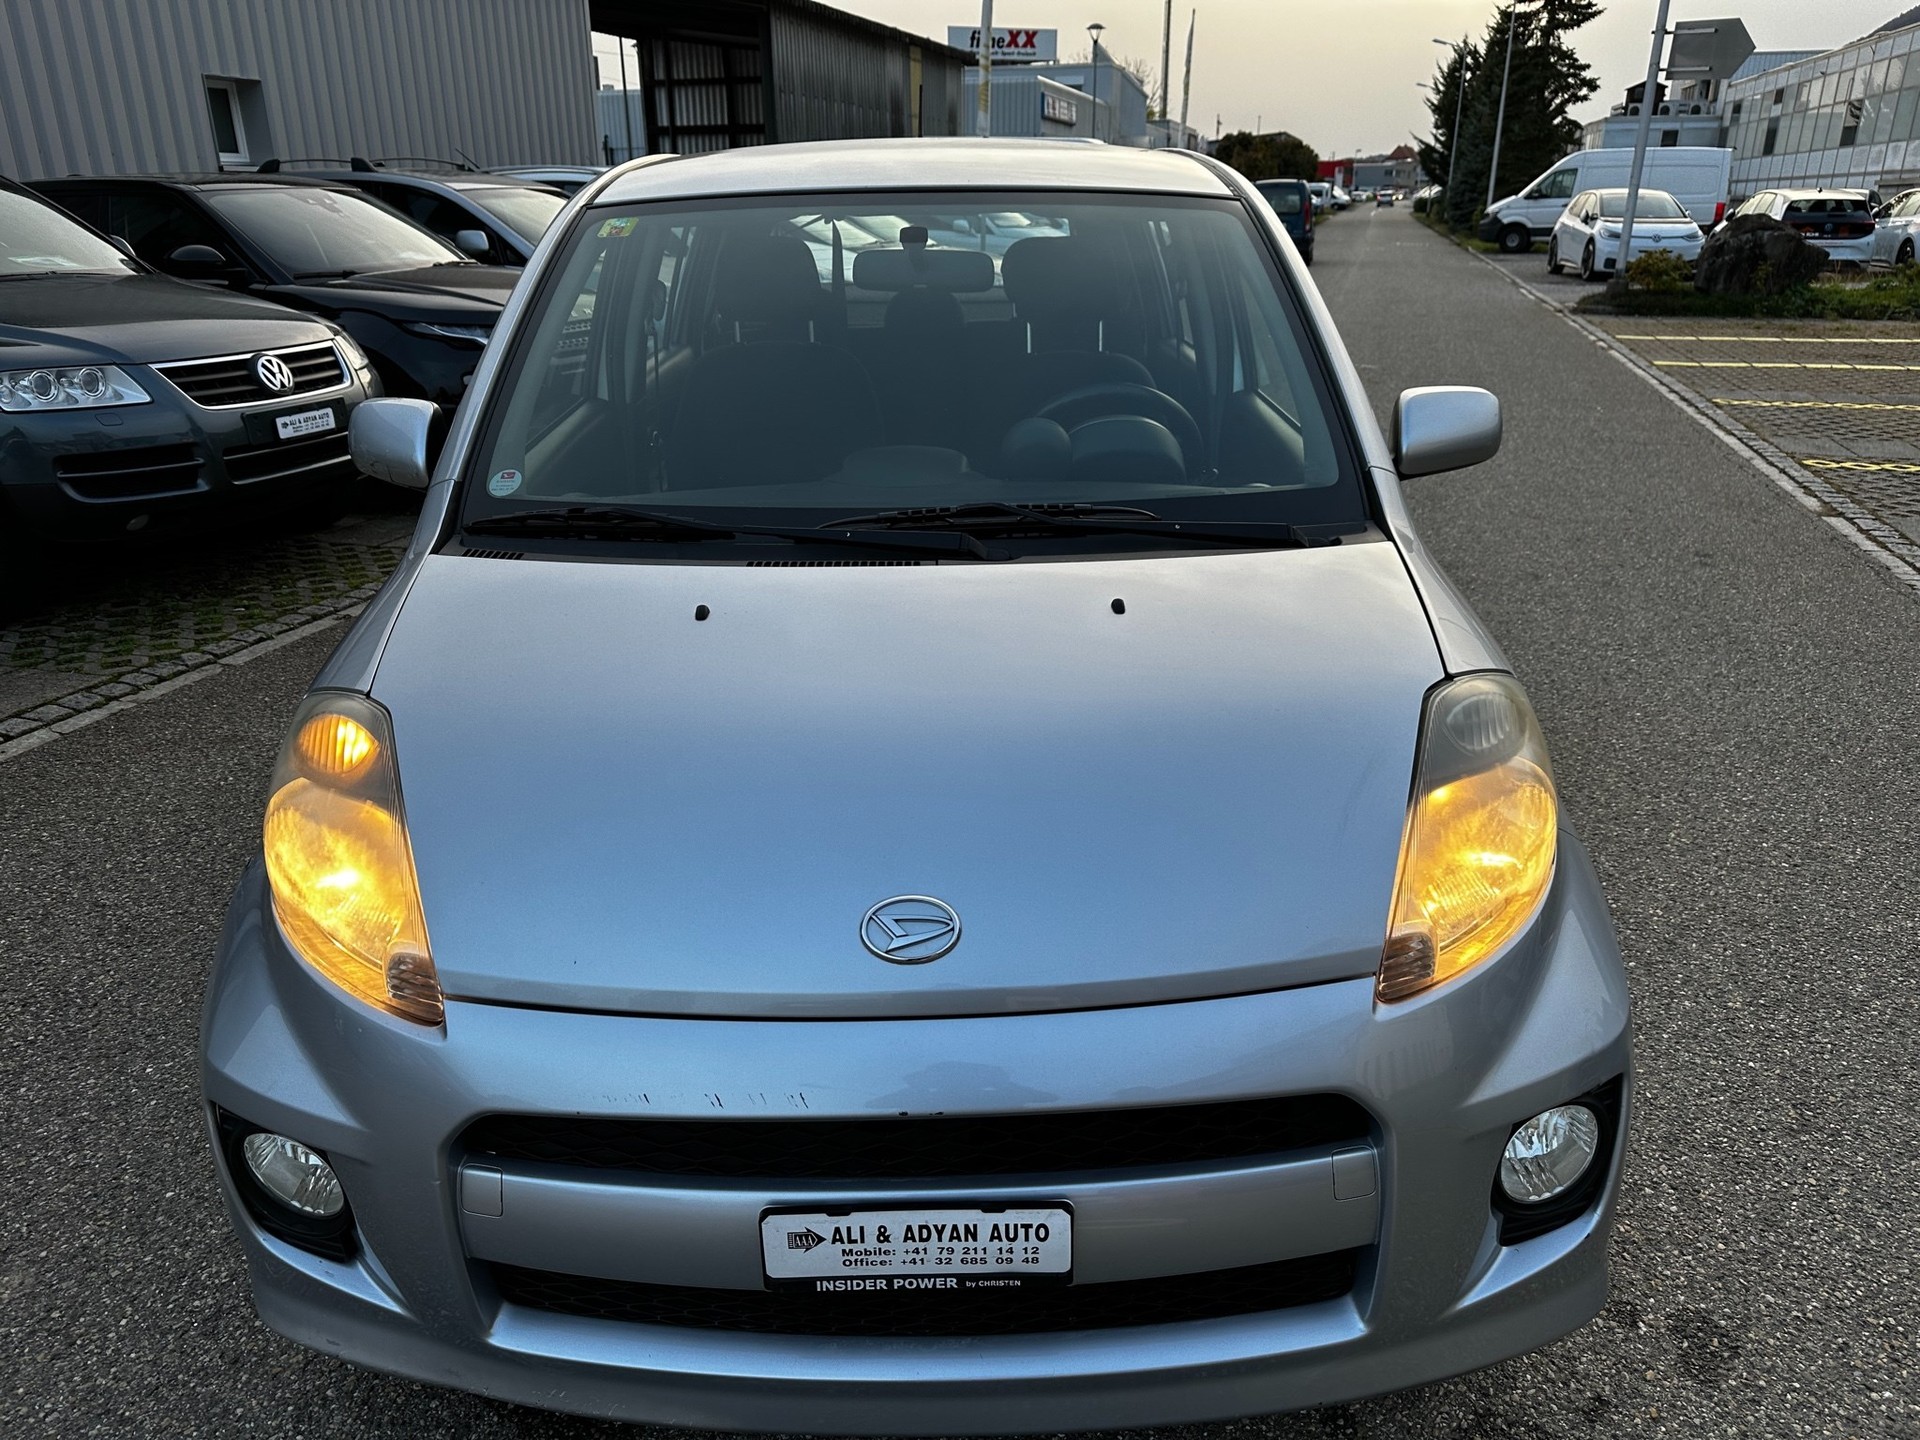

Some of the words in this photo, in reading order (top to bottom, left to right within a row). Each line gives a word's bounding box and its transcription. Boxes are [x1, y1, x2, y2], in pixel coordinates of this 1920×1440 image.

[970, 29, 1038, 49] fieXX
[831, 1225, 866, 1245] ALI
[876, 1224, 892, 1244] &
[902, 1223, 978, 1243] ADYAN
[988, 1223, 1050, 1243] AUTO
[841, 1247, 896, 1257] Mobile:
[903, 1247, 928, 1256] +41
[937, 1246, 955, 1255] 79
[962, 1246, 987, 1255] 211
[997, 1246, 1014, 1255] 14
[1022, 1246, 1040, 1255] 12
[842, 1258, 893, 1267] Office:
[900, 1257, 925, 1266] +41
[934, 1257, 953, 1265] 32
[960, 1256, 988, 1265] 685
[995, 1256, 1014, 1265] 09
[1021, 1256, 1040, 1265] 48
[816, 1280, 888, 1292] INSIDER
[893, 1278, 959, 1290] POWER
